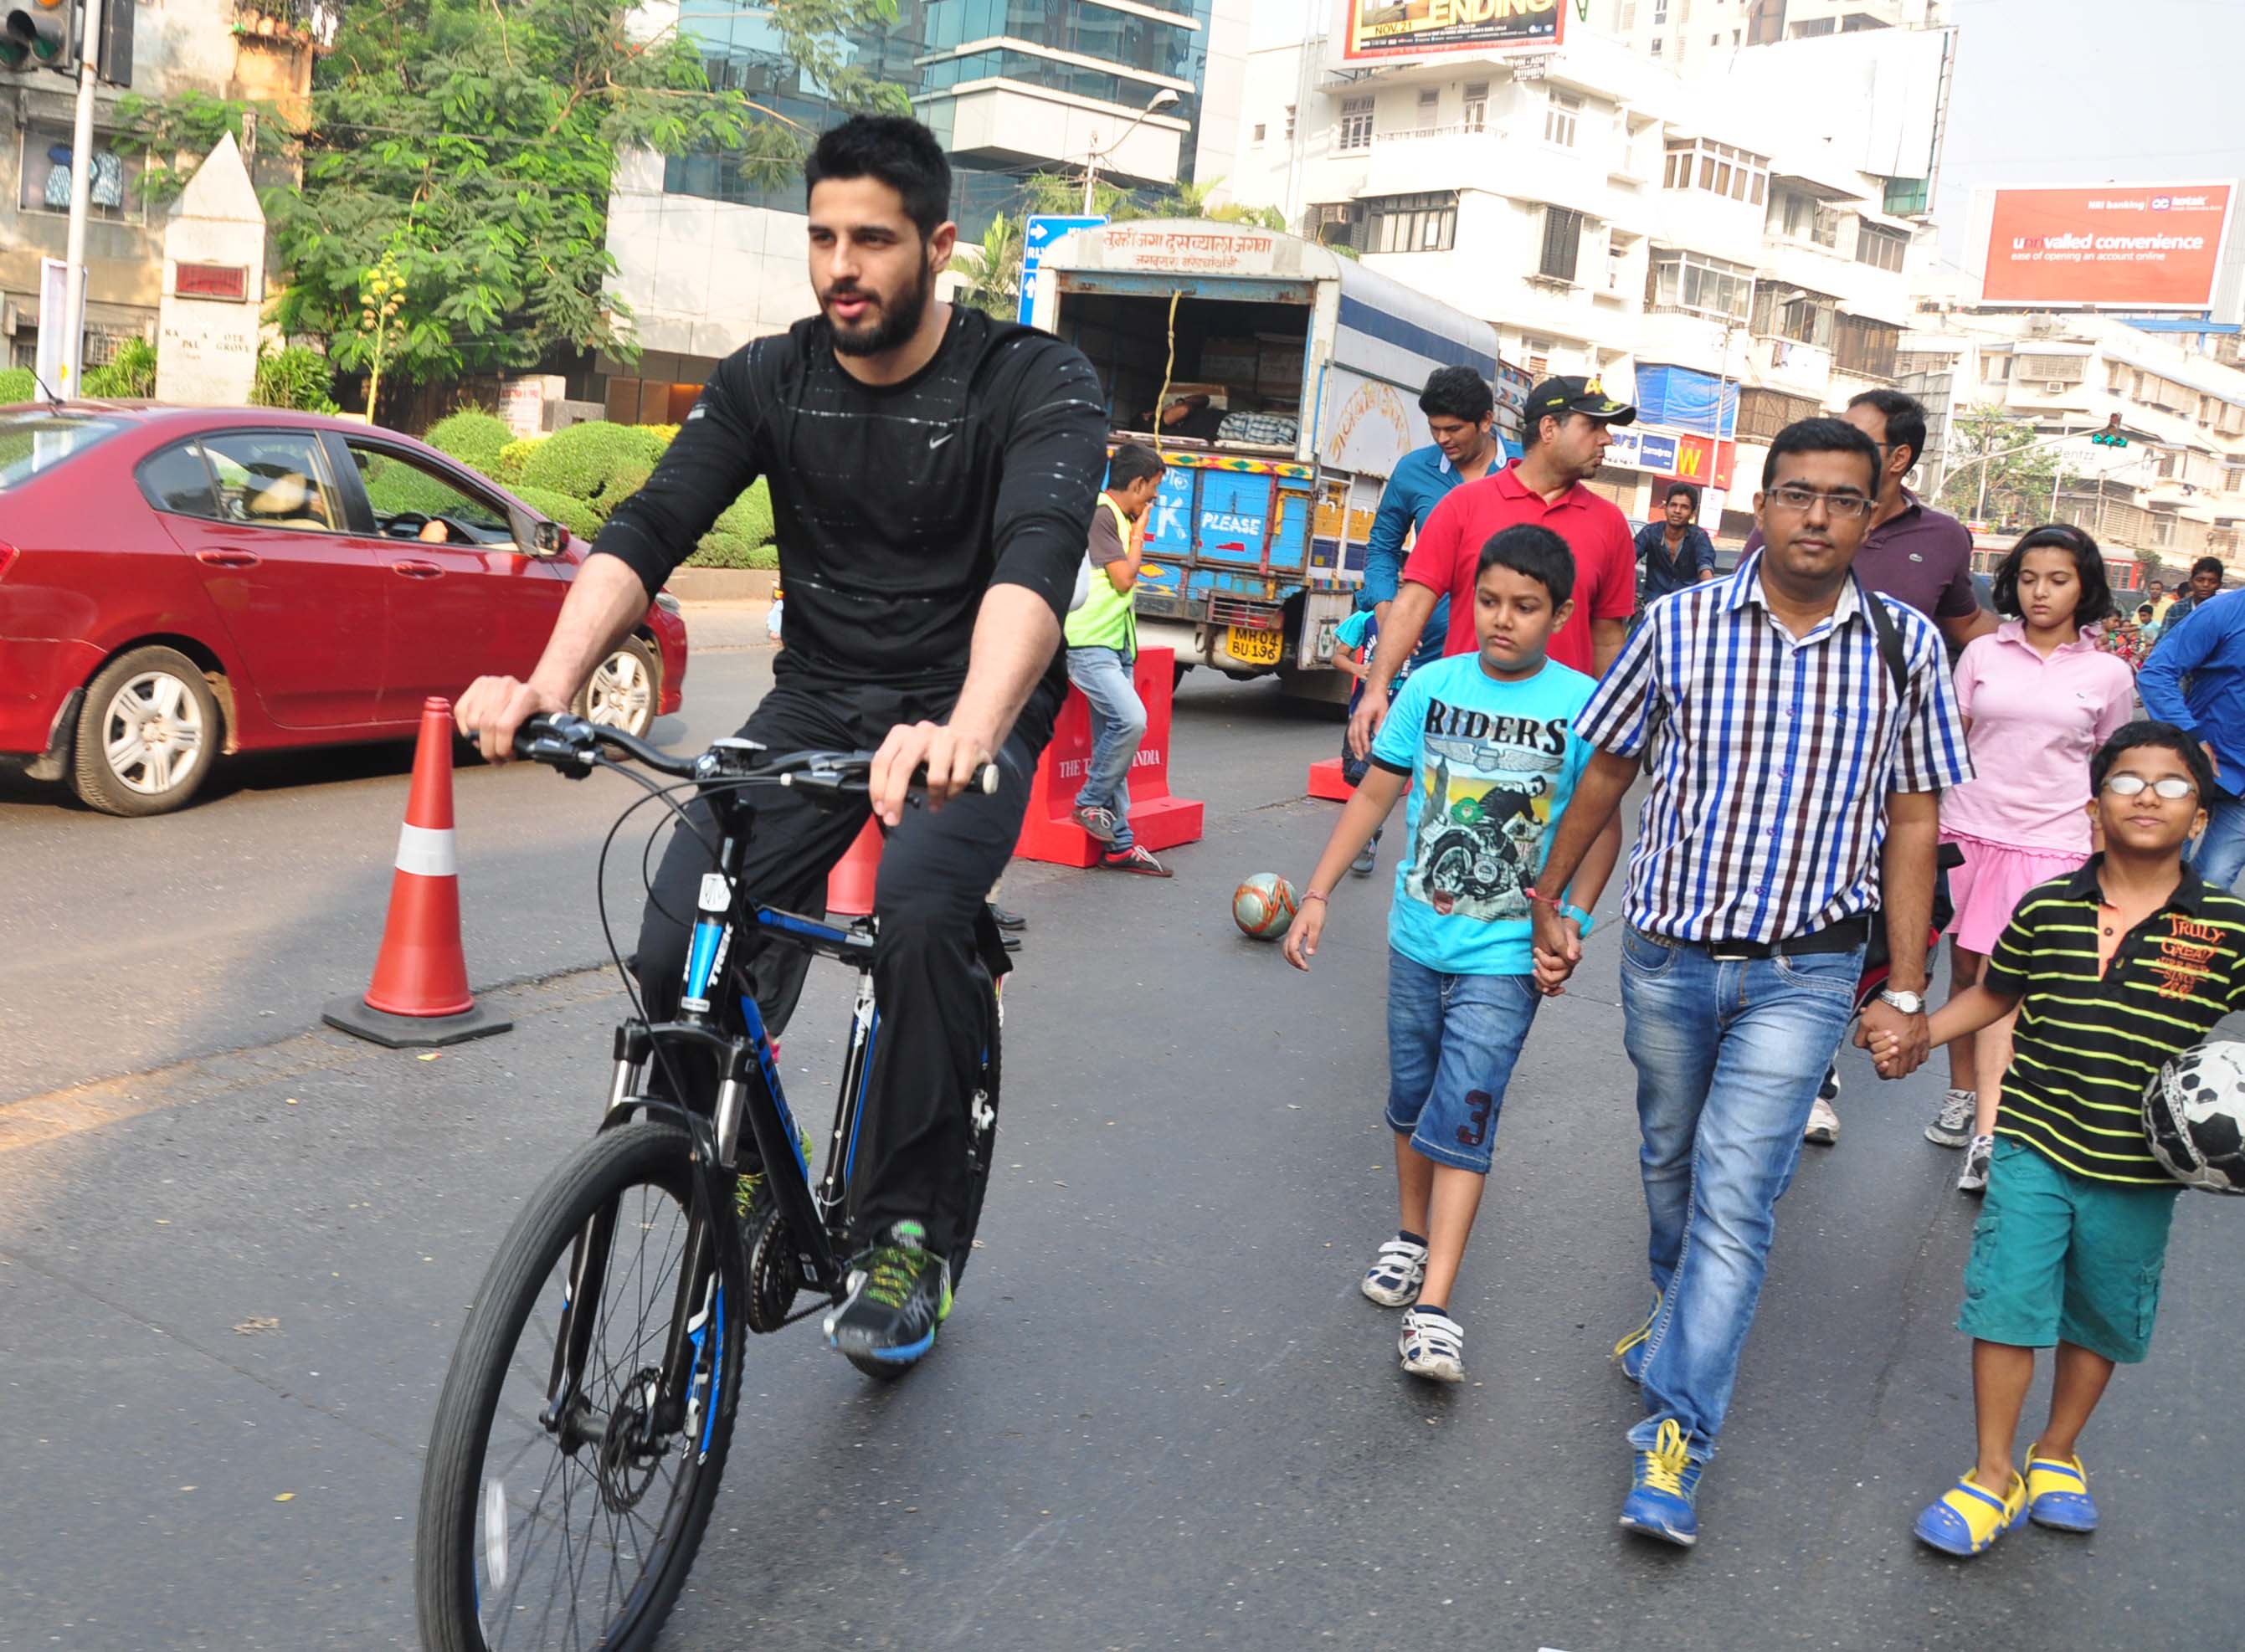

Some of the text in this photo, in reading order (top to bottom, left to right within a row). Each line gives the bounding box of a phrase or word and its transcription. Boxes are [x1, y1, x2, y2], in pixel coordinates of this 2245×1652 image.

[1401, 22, 1412, 31] 21
[2106, 200, 2145, 211] banking
[2095, 233, 2203, 249] convenience
[2011, 253, 2031, 261] ease
[2032, 252, 2042, 261] of
[2044, 252, 2081, 262] opening
[2097, 253, 2134, 261] account
[2136, 253, 2165, 261] online
[1201, 512, 1261, 536] PLEASE
[1251, 644, 1276, 660] 196
[1425, 696, 1569, 755] RIDERS
[1059, 759, 1081, 778] THE
[1456, 1090, 1492, 1147] 3
